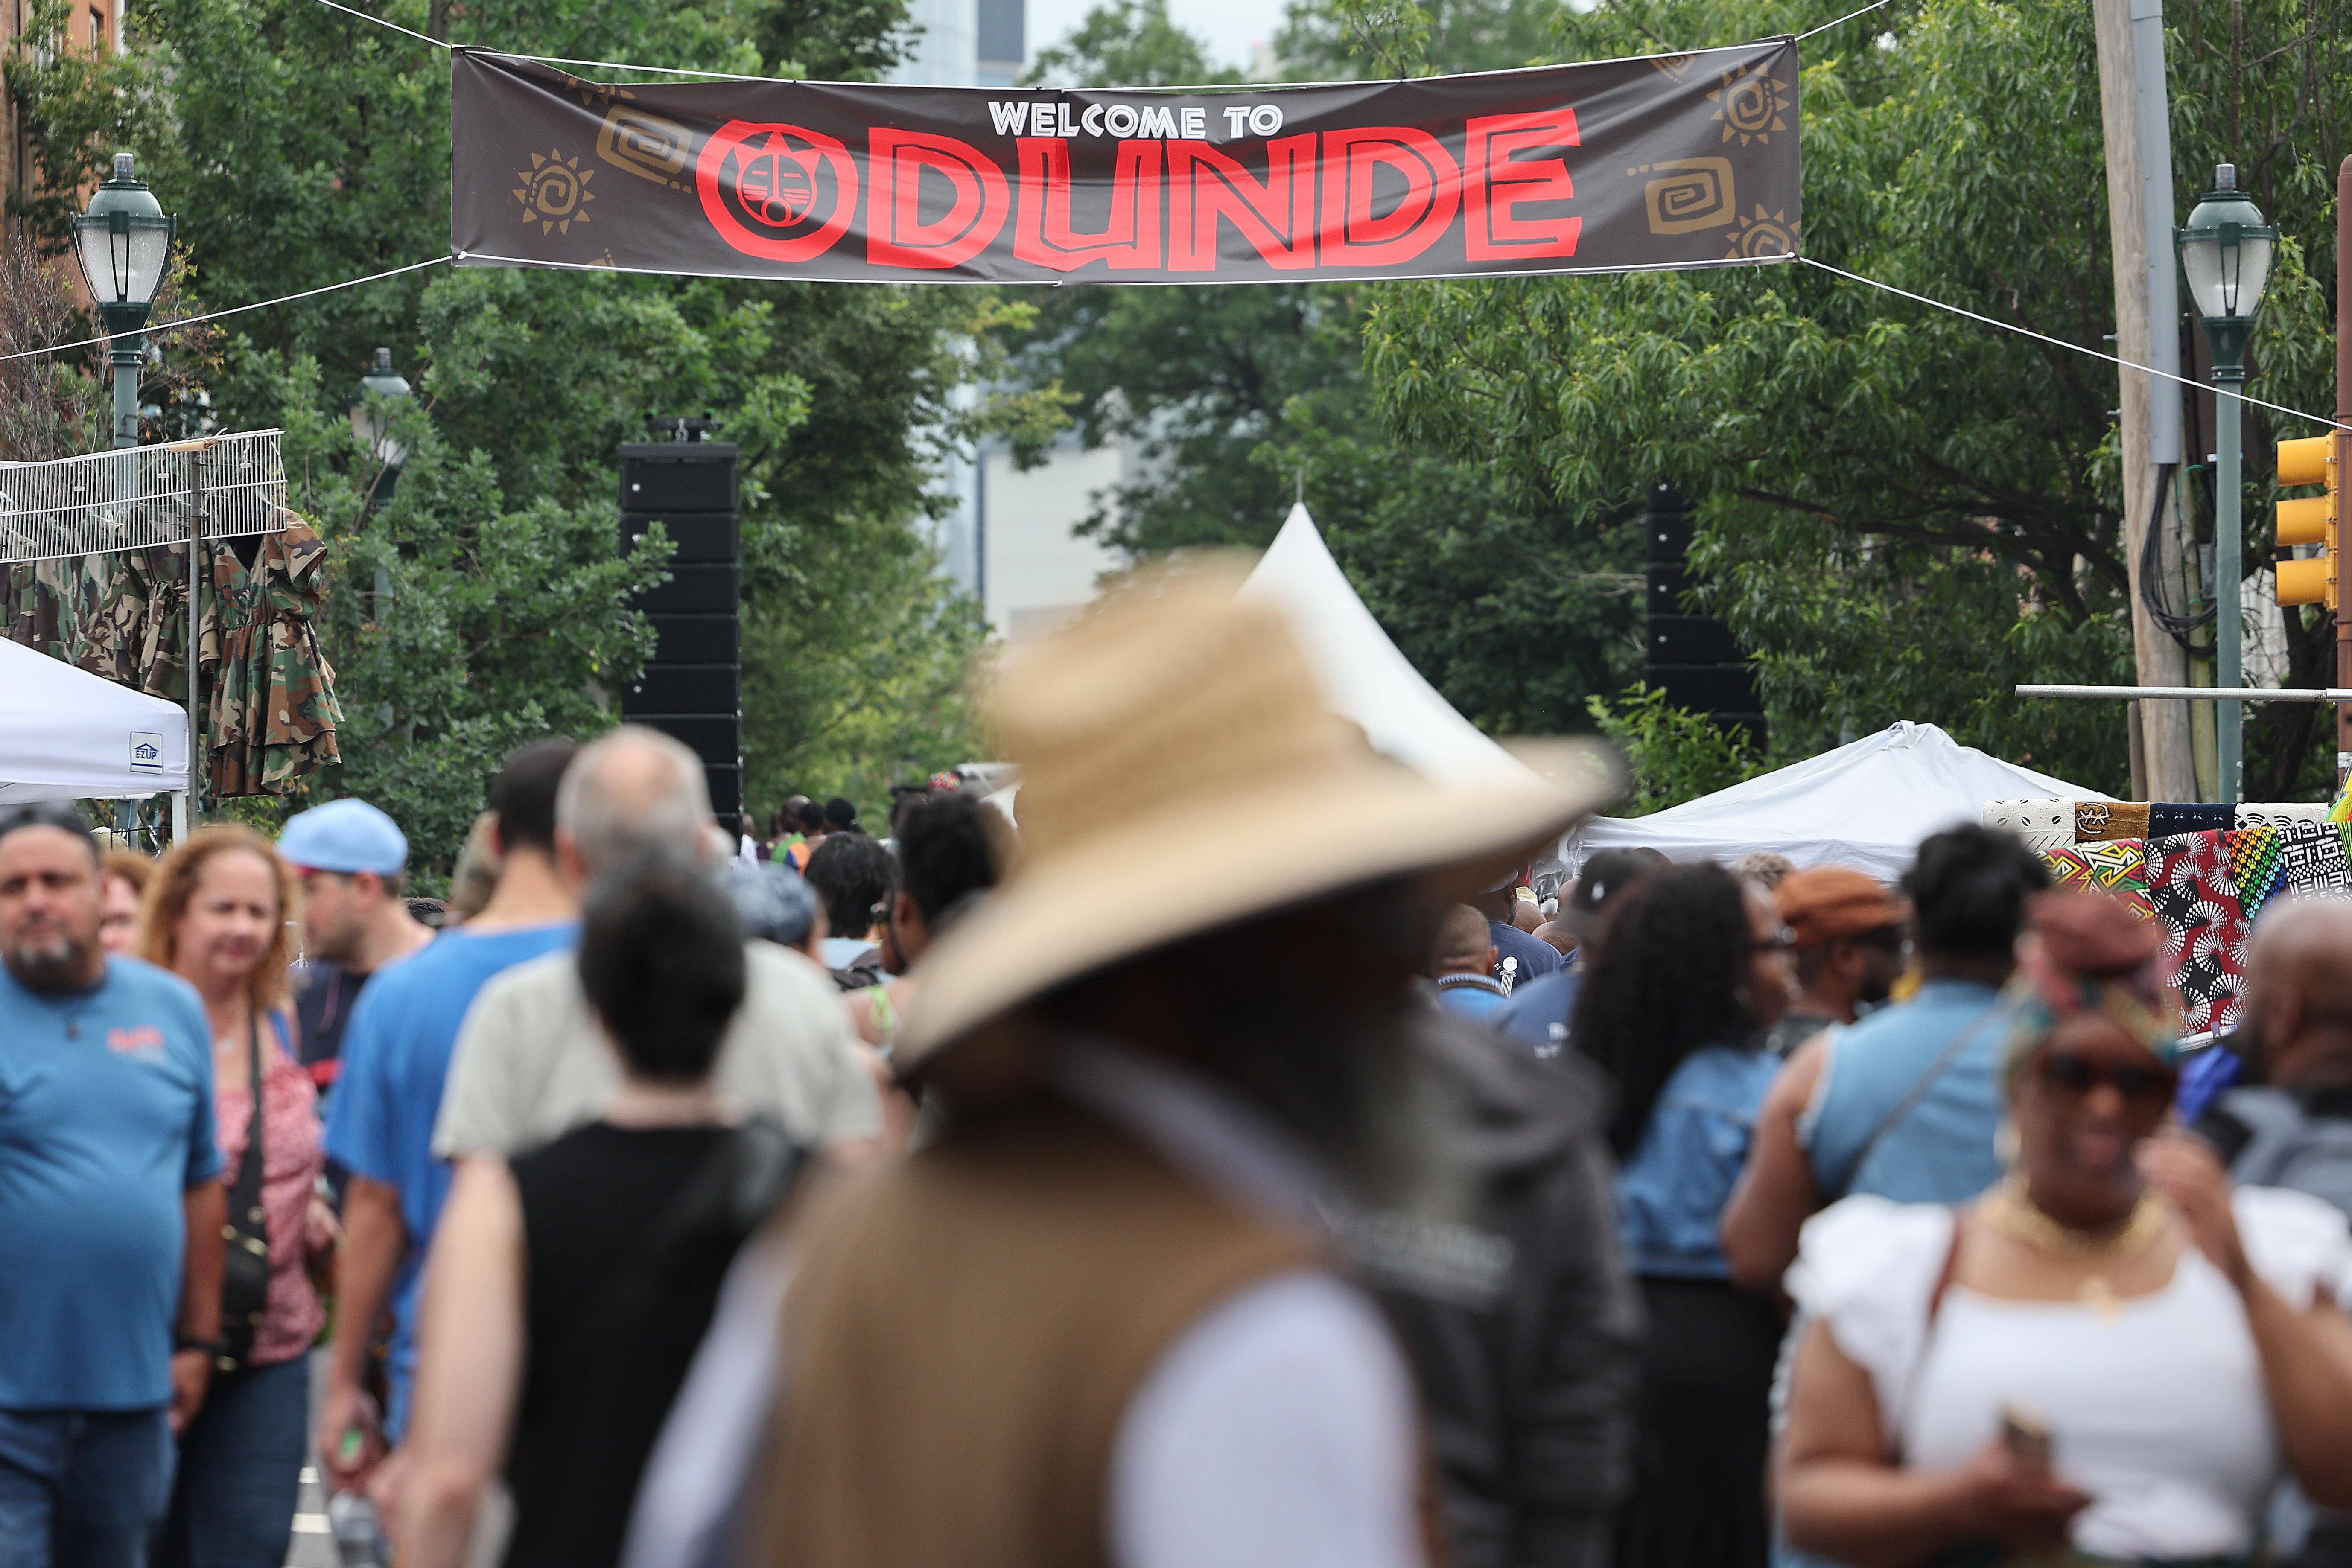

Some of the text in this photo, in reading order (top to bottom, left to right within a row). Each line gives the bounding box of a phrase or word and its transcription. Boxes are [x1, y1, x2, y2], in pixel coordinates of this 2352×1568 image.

[988, 101, 1284, 139] WELCOME TO
[695, 108, 1582, 271] ODUNDE
